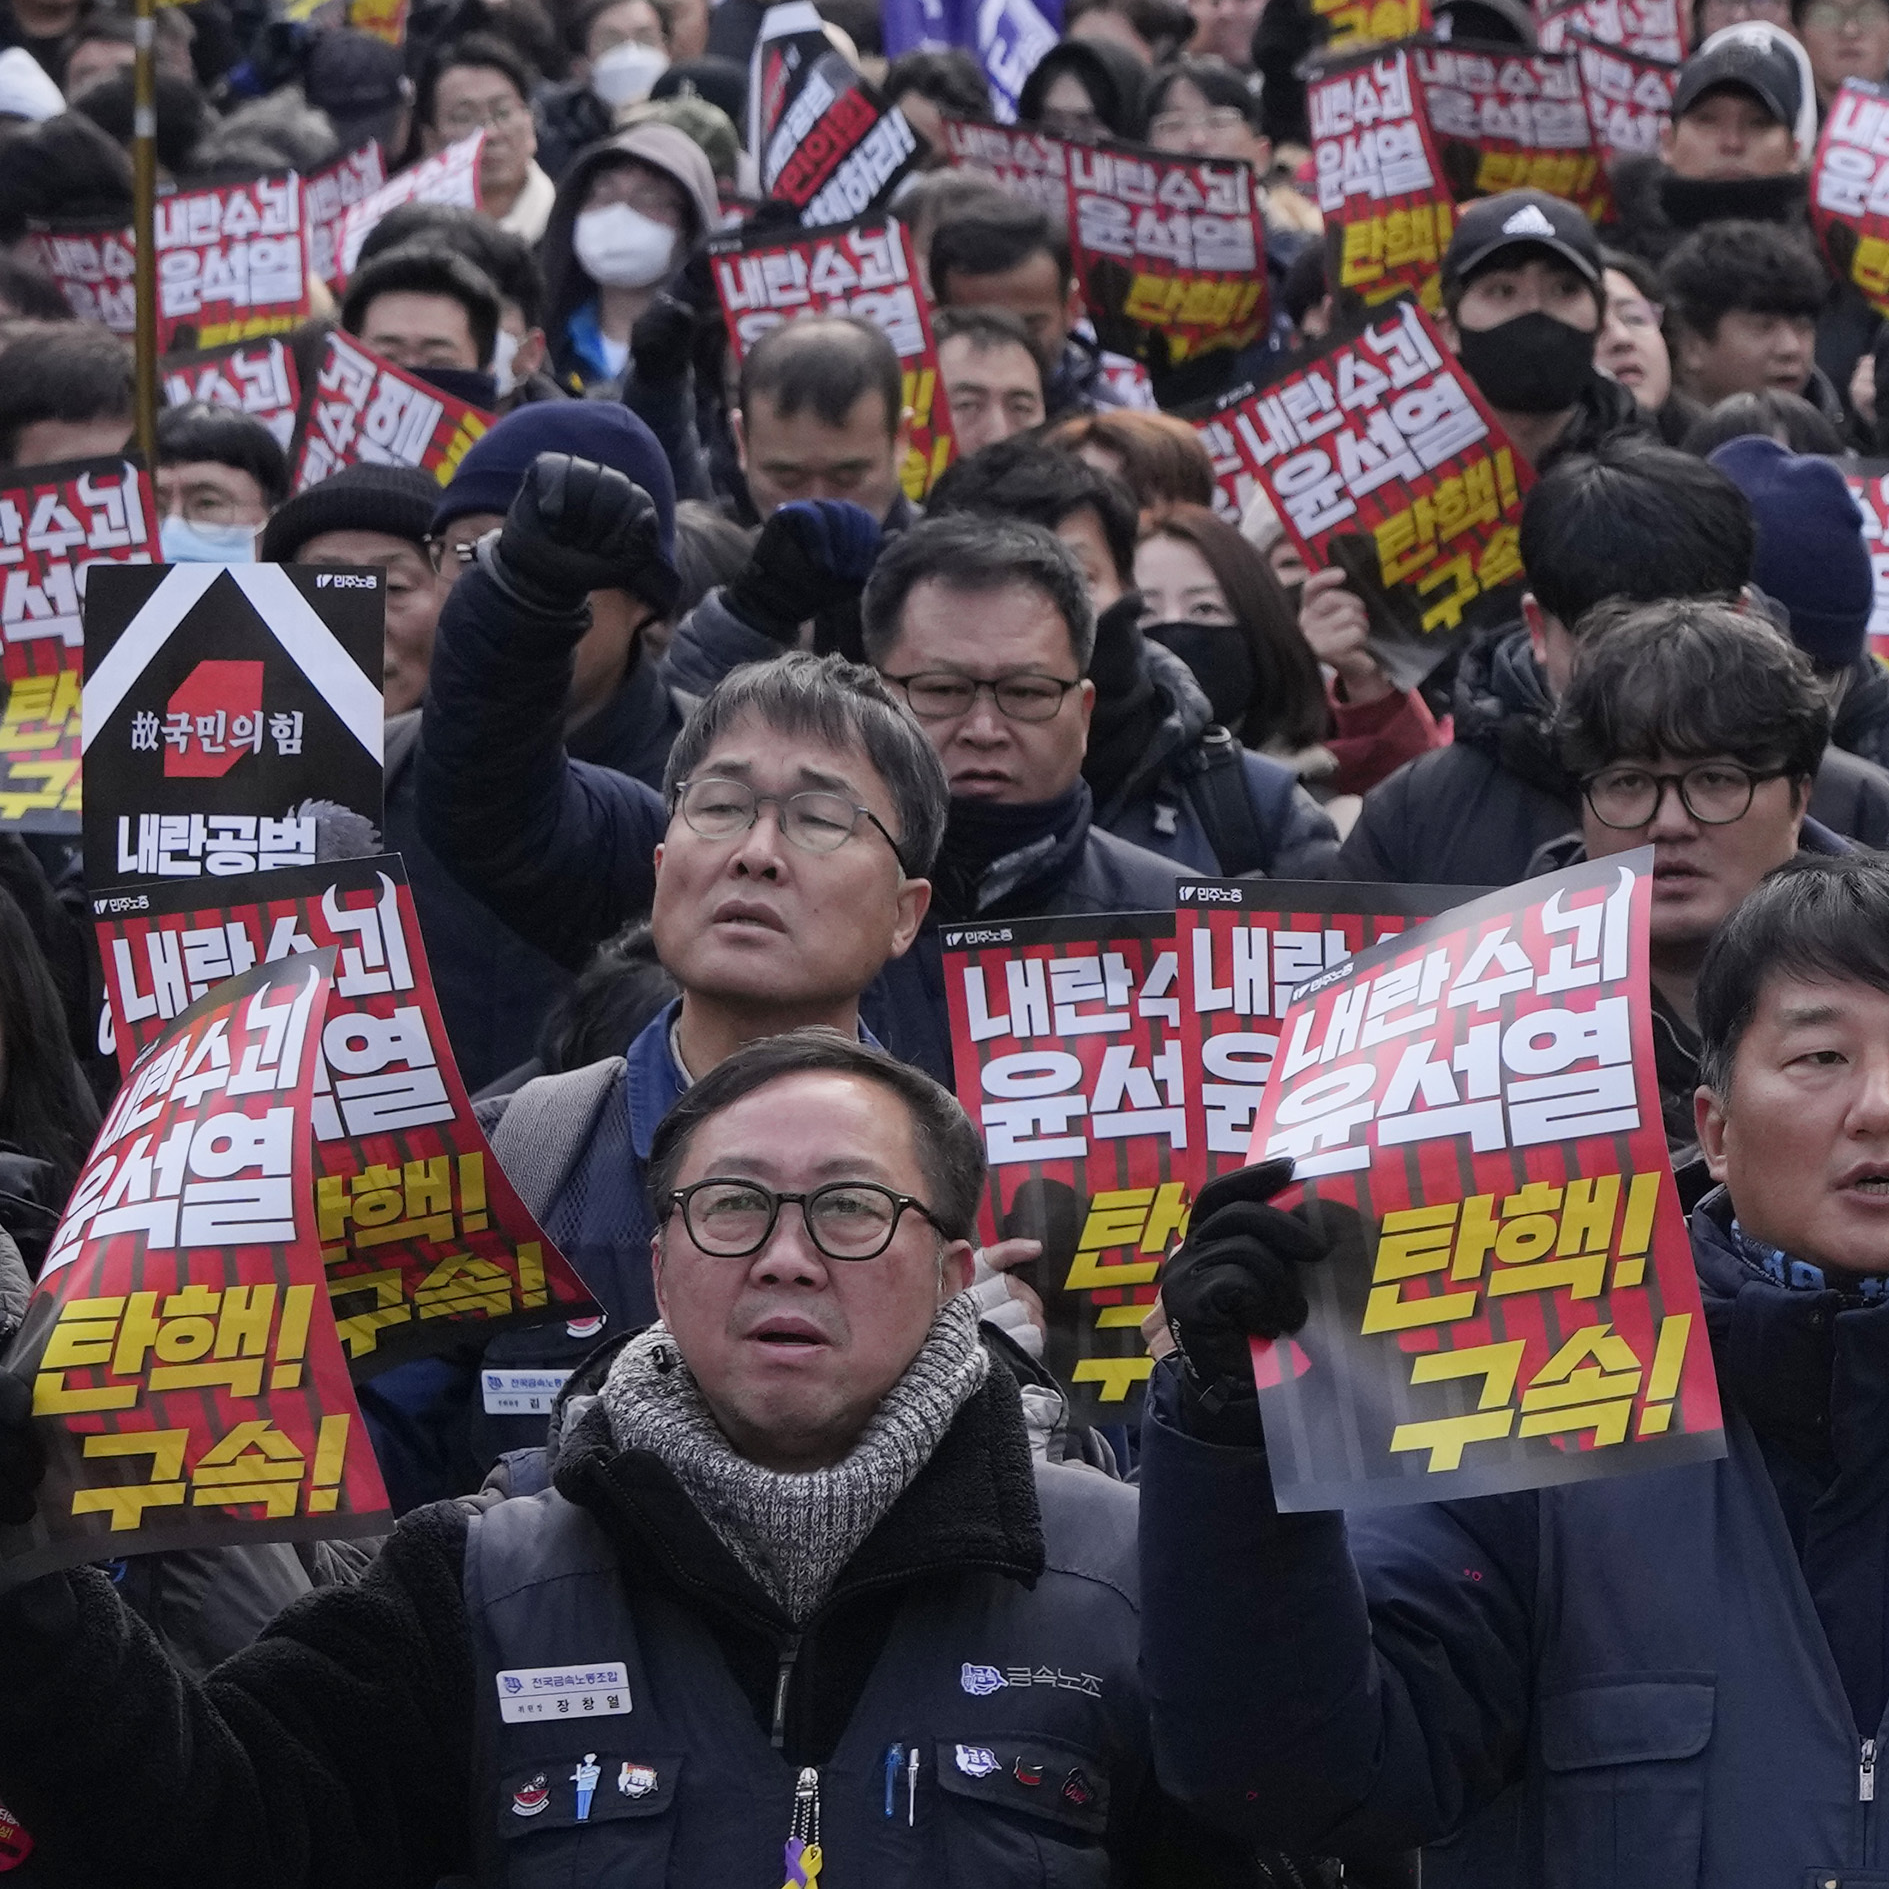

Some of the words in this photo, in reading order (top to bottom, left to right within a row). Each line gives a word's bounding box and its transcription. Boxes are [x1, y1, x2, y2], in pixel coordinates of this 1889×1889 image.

[1309, 48, 1417, 140] 내란수괴
[154, 170, 301, 238] 내란수괴
[1069, 147, 1251, 215] 내란수괴
[1315, 123, 1436, 212] 윤석열
[157, 238, 303, 319] 윤석열
[718, 215, 907, 311] 내란수괴
[1077, 193, 1257, 272] 윤석열
[1236, 300, 1445, 465] 내란수괴
[1271, 368, 1490, 540] 윤석열
[1375, 447, 1521, 589] 탄핵!
[118, 813, 317, 877] 내란공범
[1198, 885, 1243, 904] 민주노총
[1280, 865, 1634, 1082] 내란수괴
[88, 964, 319, 1167] 내란수괴
[981, 1038, 1186, 1166] 윤석
[1265, 996, 1641, 1182] 윤석열
[40, 1107, 297, 1281] 윤석열
[1360, 1171, 1662, 1337] 탄핵!
[32, 1281, 313, 1417] 탄핵!
[510, 1378, 563, 1390] 전국금속노동
[1390, 1313, 1691, 1473] 구속!
[71, 1411, 352, 1531] 구속!
[531, 1671, 618, 1690] 전국금속노동조합
[1006, 1664, 1104, 1699] 금속노조
